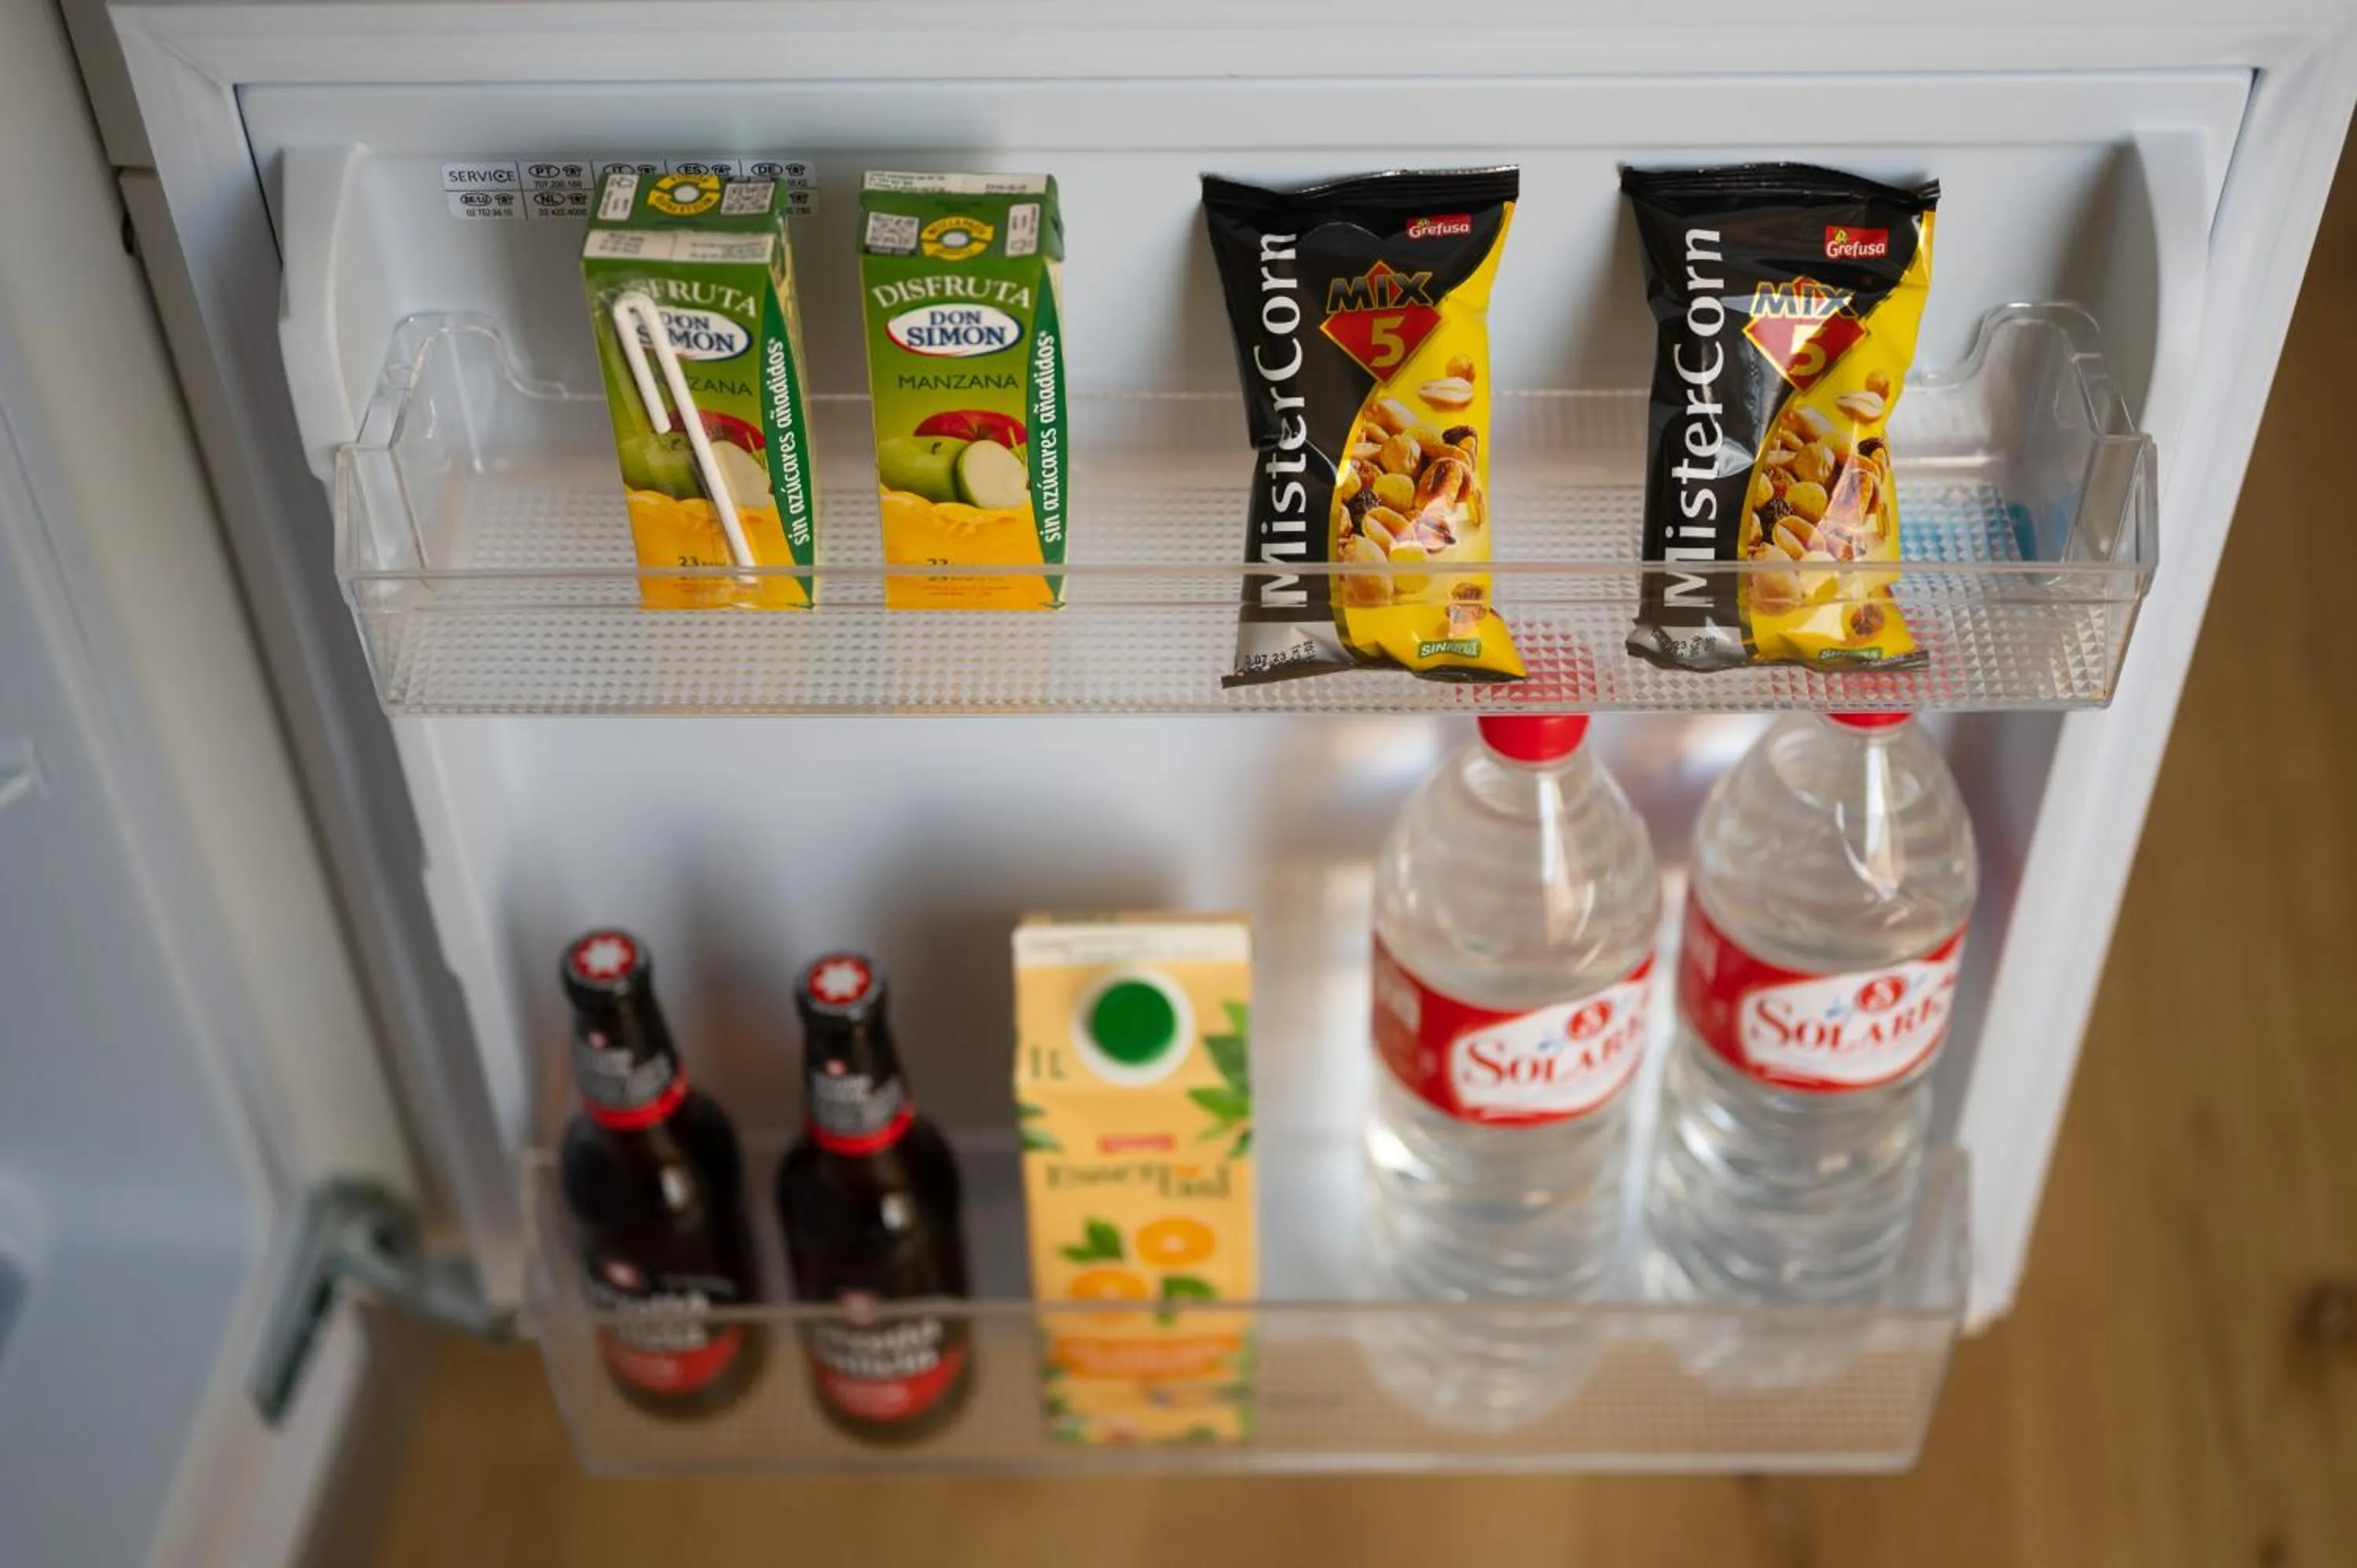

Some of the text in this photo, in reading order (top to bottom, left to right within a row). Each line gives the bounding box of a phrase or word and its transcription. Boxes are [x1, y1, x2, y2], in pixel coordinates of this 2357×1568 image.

[449, 170, 515, 183] SERVICE
[1409, 221, 1469, 238] Grefusa
[1827, 240, 1886, 257] Grefusa
[872, 275, 1031, 309] DISFRUTA
[1326, 271, 1435, 314] MIX
[1750, 281, 1859, 318] MIX
[929, 311, 982, 325] DON
[636, 324, 740, 353] SMON
[907, 326, 1006, 347] SIMON
[1369, 317, 1406, 368] 5
[1787, 324, 1829, 376] 5
[898, 374, 1019, 390] MANZANA
[779, 430, 805, 515] azúcares
[1037, 427, 1061, 511] azúcares
[788, 515, 810, 546] sin
[1039, 514, 1061, 543] sin
